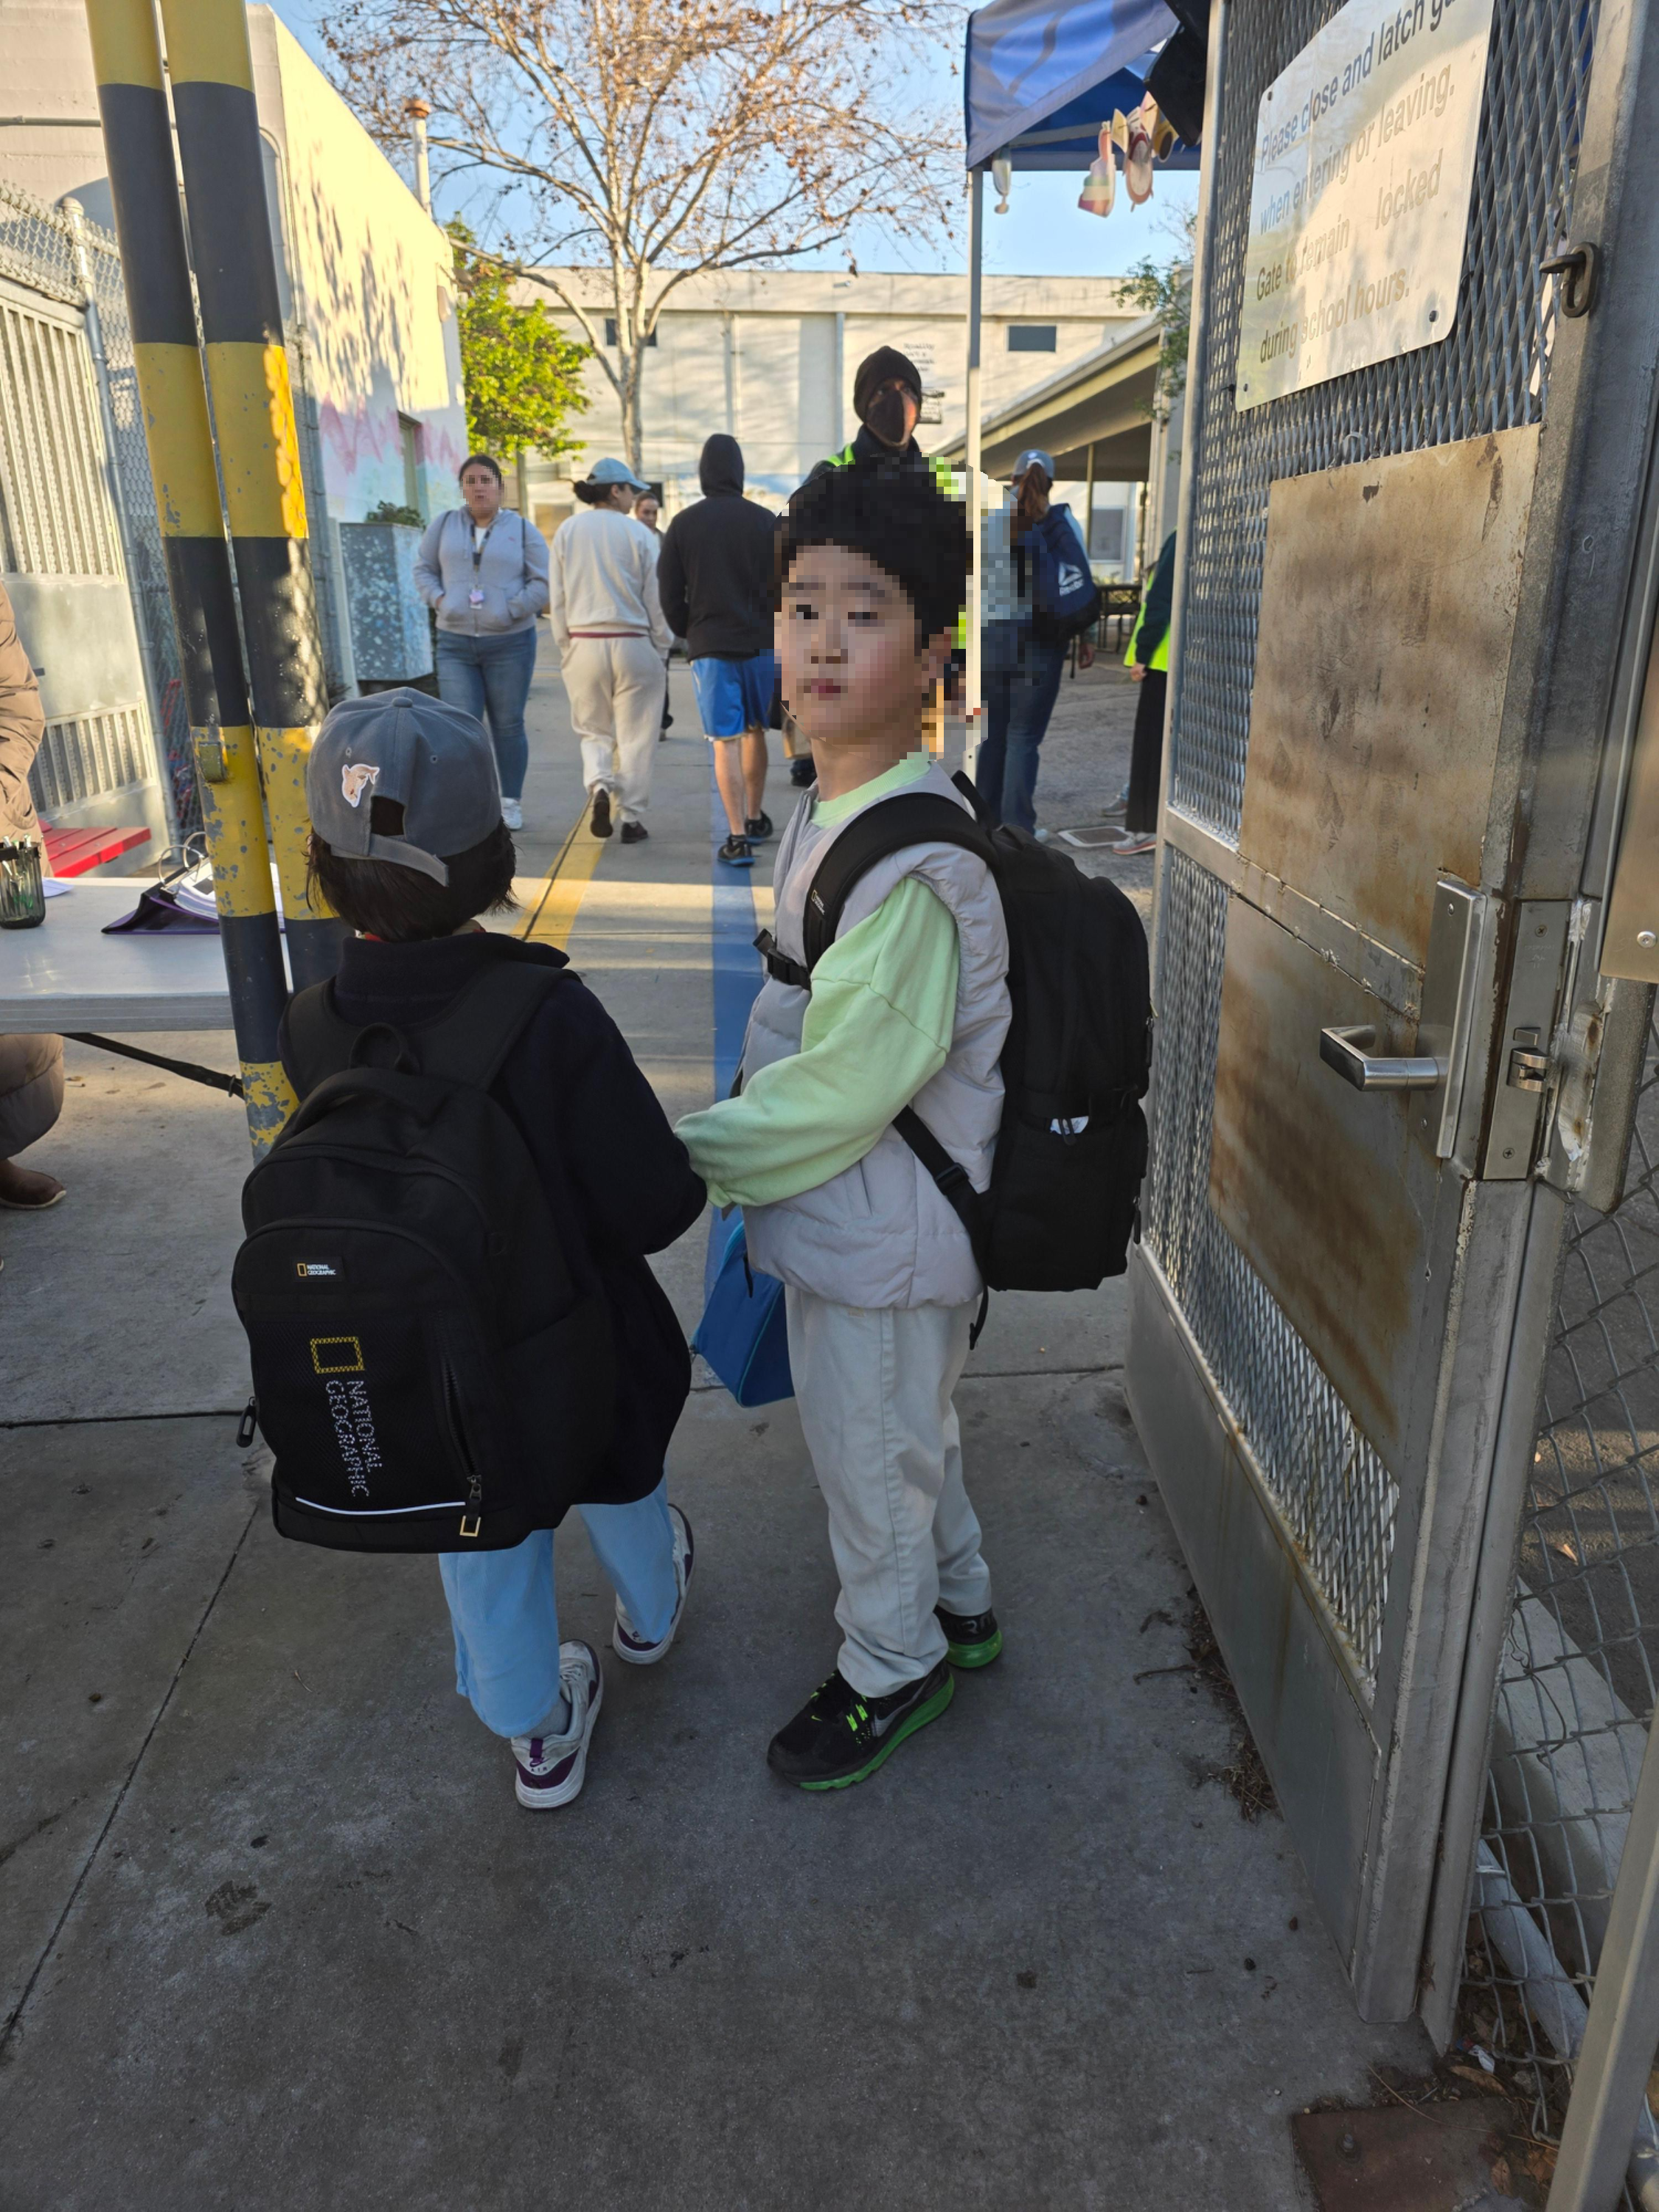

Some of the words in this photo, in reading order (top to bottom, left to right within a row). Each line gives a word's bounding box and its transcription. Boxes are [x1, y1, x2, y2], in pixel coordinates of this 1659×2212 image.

[1260, 189, 1290, 236] when
[1293, 142, 1352, 210] entering
[1355, 121, 1375, 163] or
[1377, 63, 1455, 147] leaving.
[1261, 114, 1298, 172] Please
[1301, 74, 1338, 133] close
[1342, 30, 1374, 97] and
[1377, 0, 1425, 66] latch
[1256, 261, 1282, 302] Gate
[1286, 251, 1298, 285] to
[1299, 213, 1350, 276] remain
[1375, 147, 1444, 231] locked
[1260, 320, 1298, 364] during
[1301, 285, 1351, 344] school
[1353, 268, 1410, 320] hours.
[325, 1380, 369, 1498] GEOGRAPHIC
[347, 1380, 383, 1472] NATIONAL
